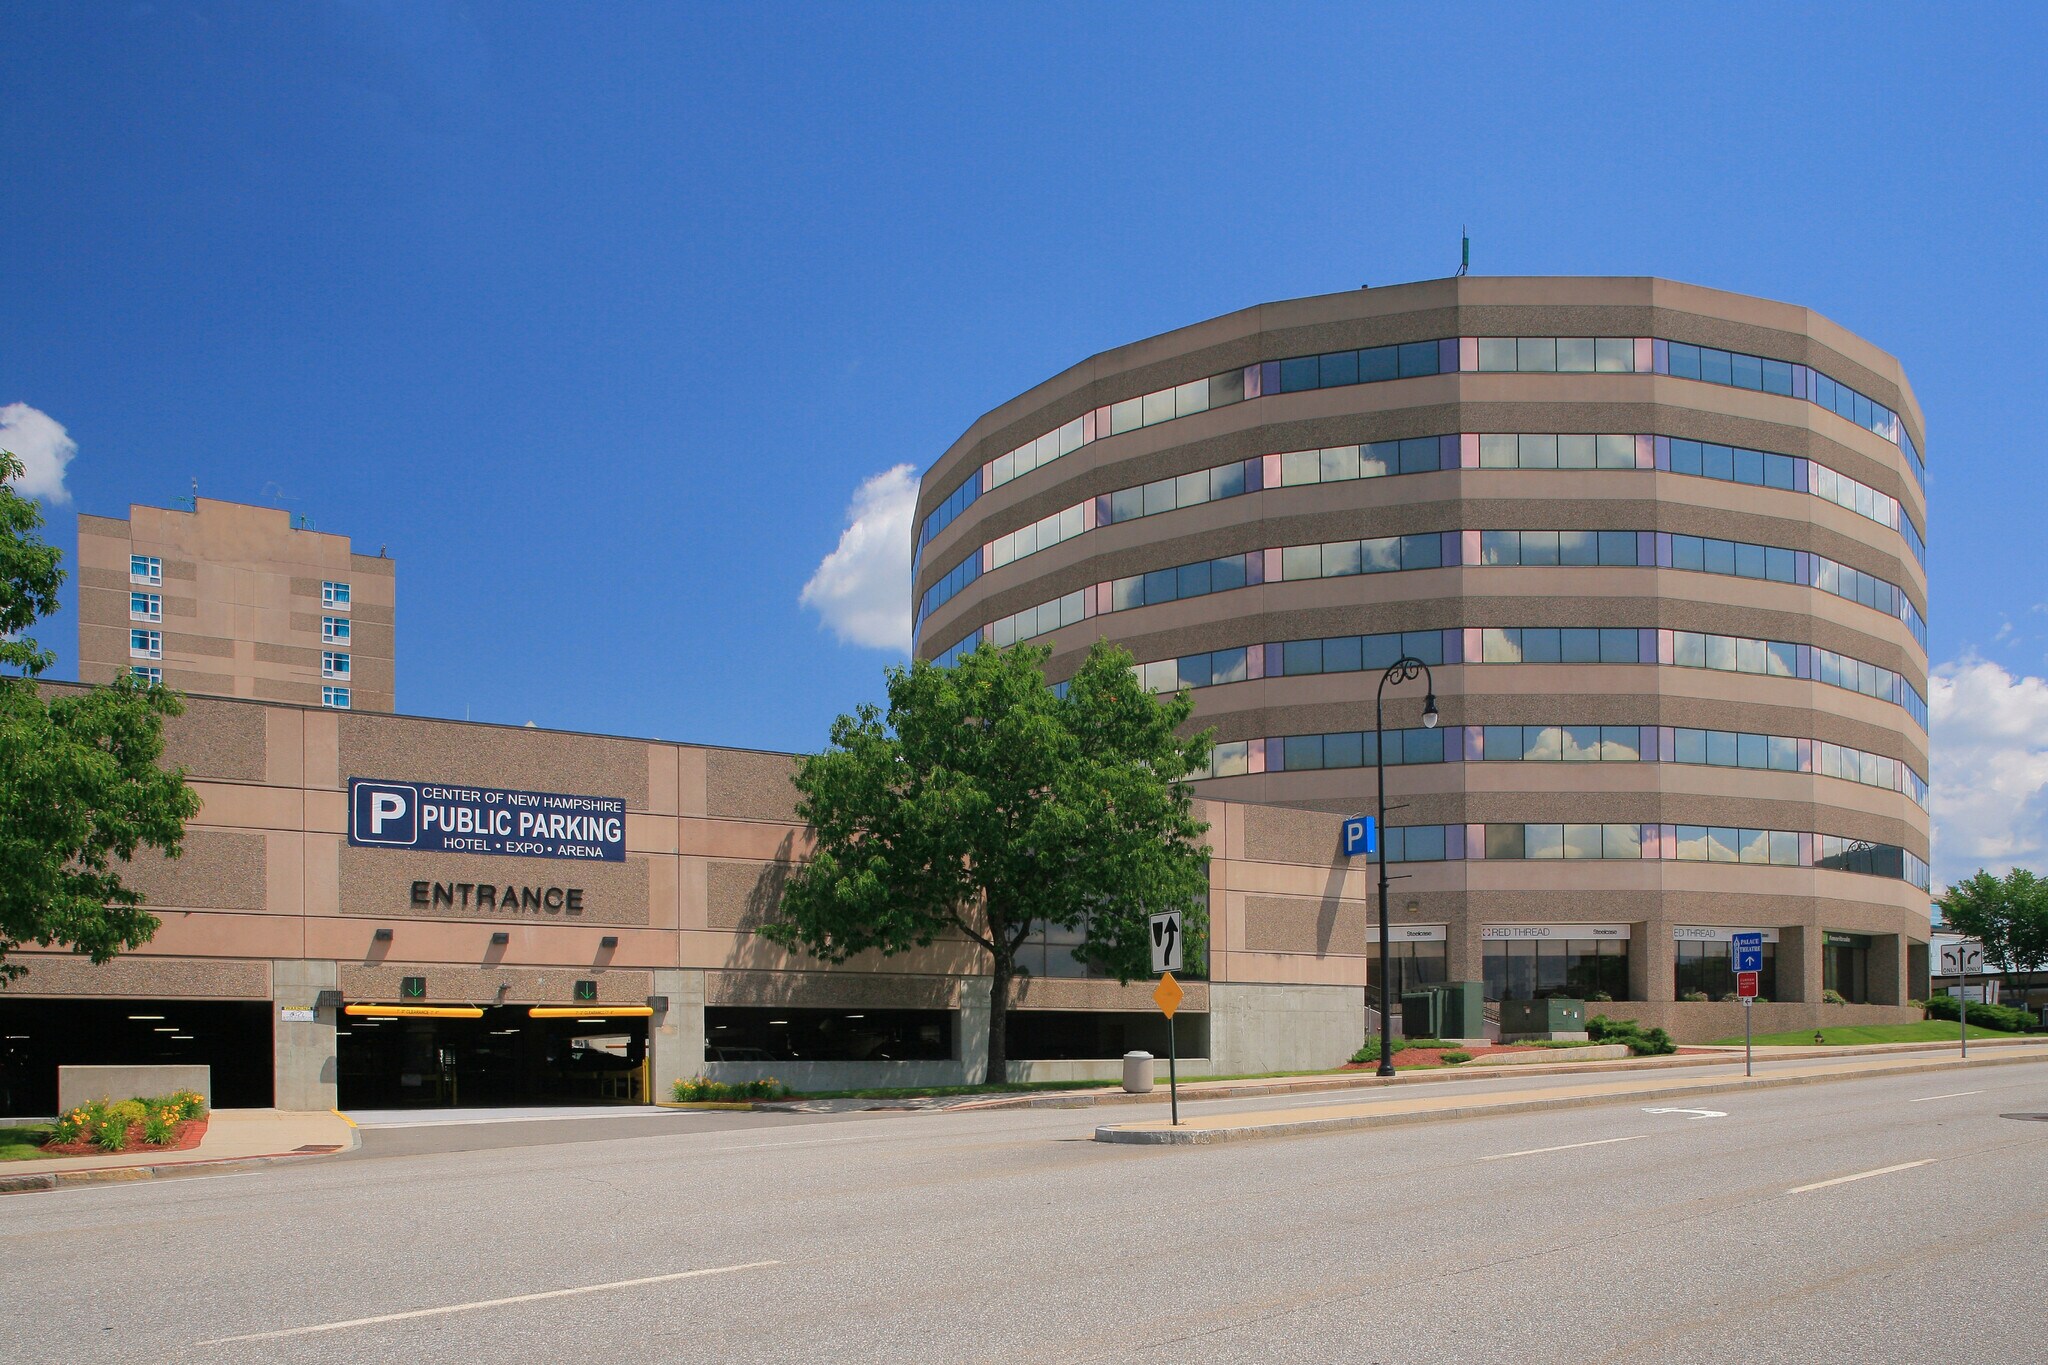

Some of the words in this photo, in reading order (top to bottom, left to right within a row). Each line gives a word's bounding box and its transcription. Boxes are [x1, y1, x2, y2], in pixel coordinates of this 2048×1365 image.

[371, 792, 406, 834] P
[422, 787, 481, 802] CENTER
[484, 792, 504, 804] OF
[508, 794, 540, 807] NEW
[543, 797, 622, 813] HAMPSHIRE
[423, 805, 512, 836] PUBLIC
[519, 812, 621, 843] PARKING
[1347, 823, 1363, 852] P
[444, 837, 491, 851] HOTEL
[506, 841, 544, 854] EXPO
[557, 845, 604, 858] ARENA
[411, 881, 584, 912] ENTRANCE
[1491, 928, 1511, 937] RED
[1514, 928, 1551, 937] THREAD
[1673, 929, 1685, 937] ED
[1686, 929, 1716, 938] THREAD
